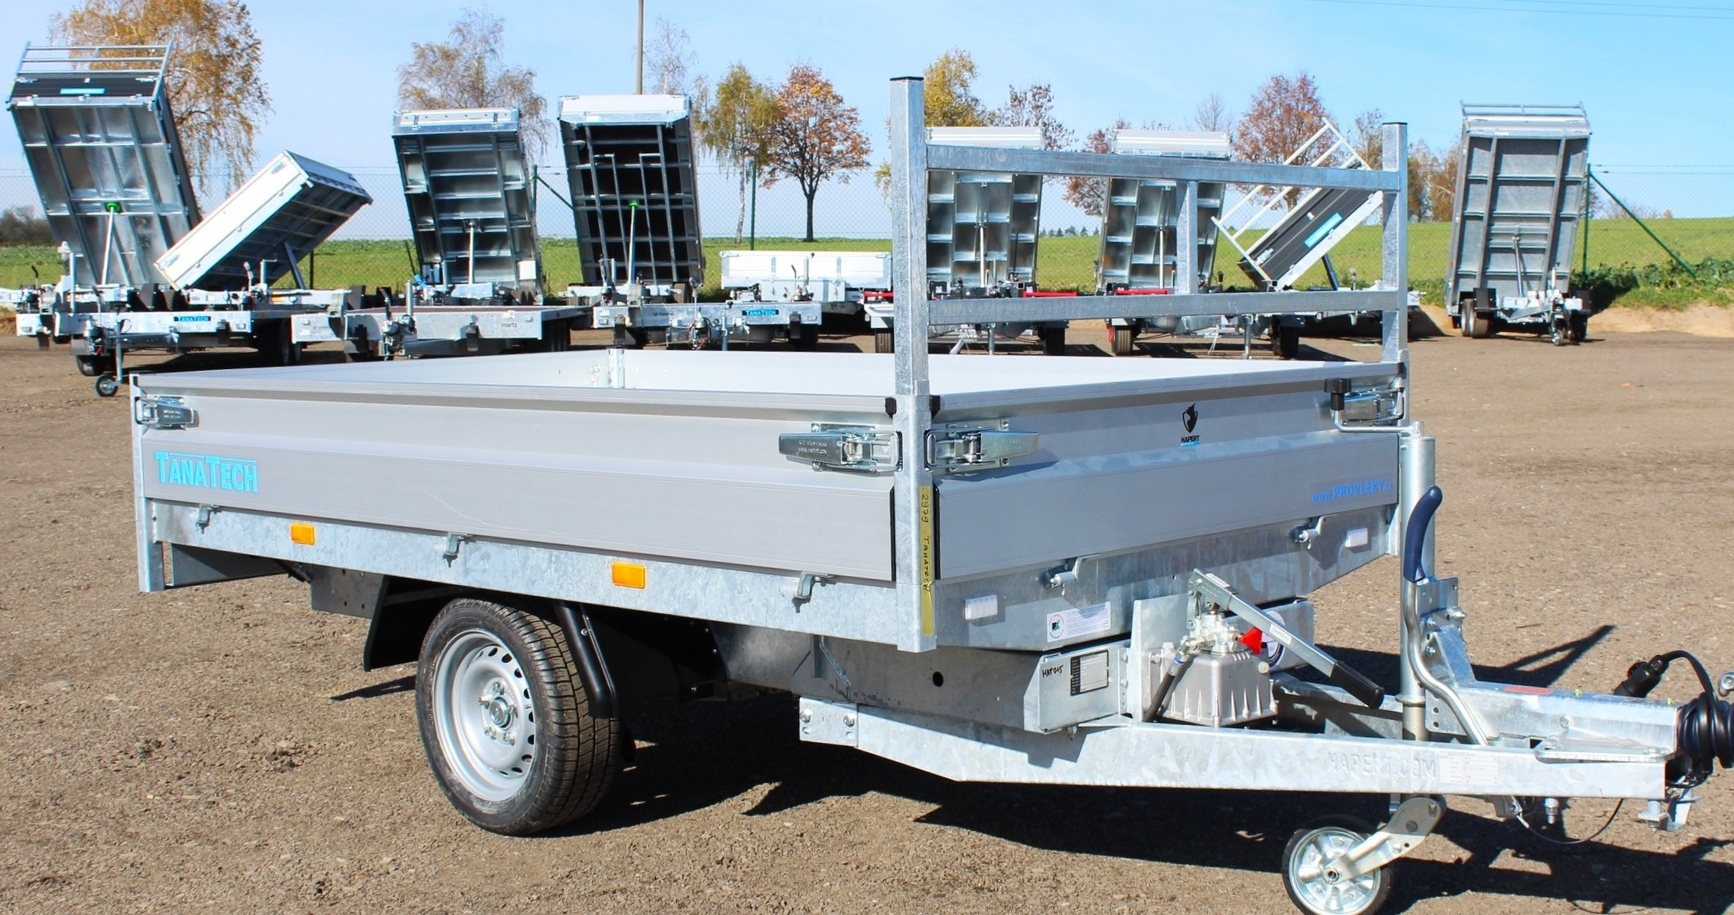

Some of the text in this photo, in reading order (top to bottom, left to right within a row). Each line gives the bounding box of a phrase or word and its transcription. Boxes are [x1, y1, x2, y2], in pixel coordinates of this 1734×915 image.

[1180, 435, 1200, 443] HAPERT
[154, 451, 258, 493] TANATECH
[921, 494, 930, 523] 2979
